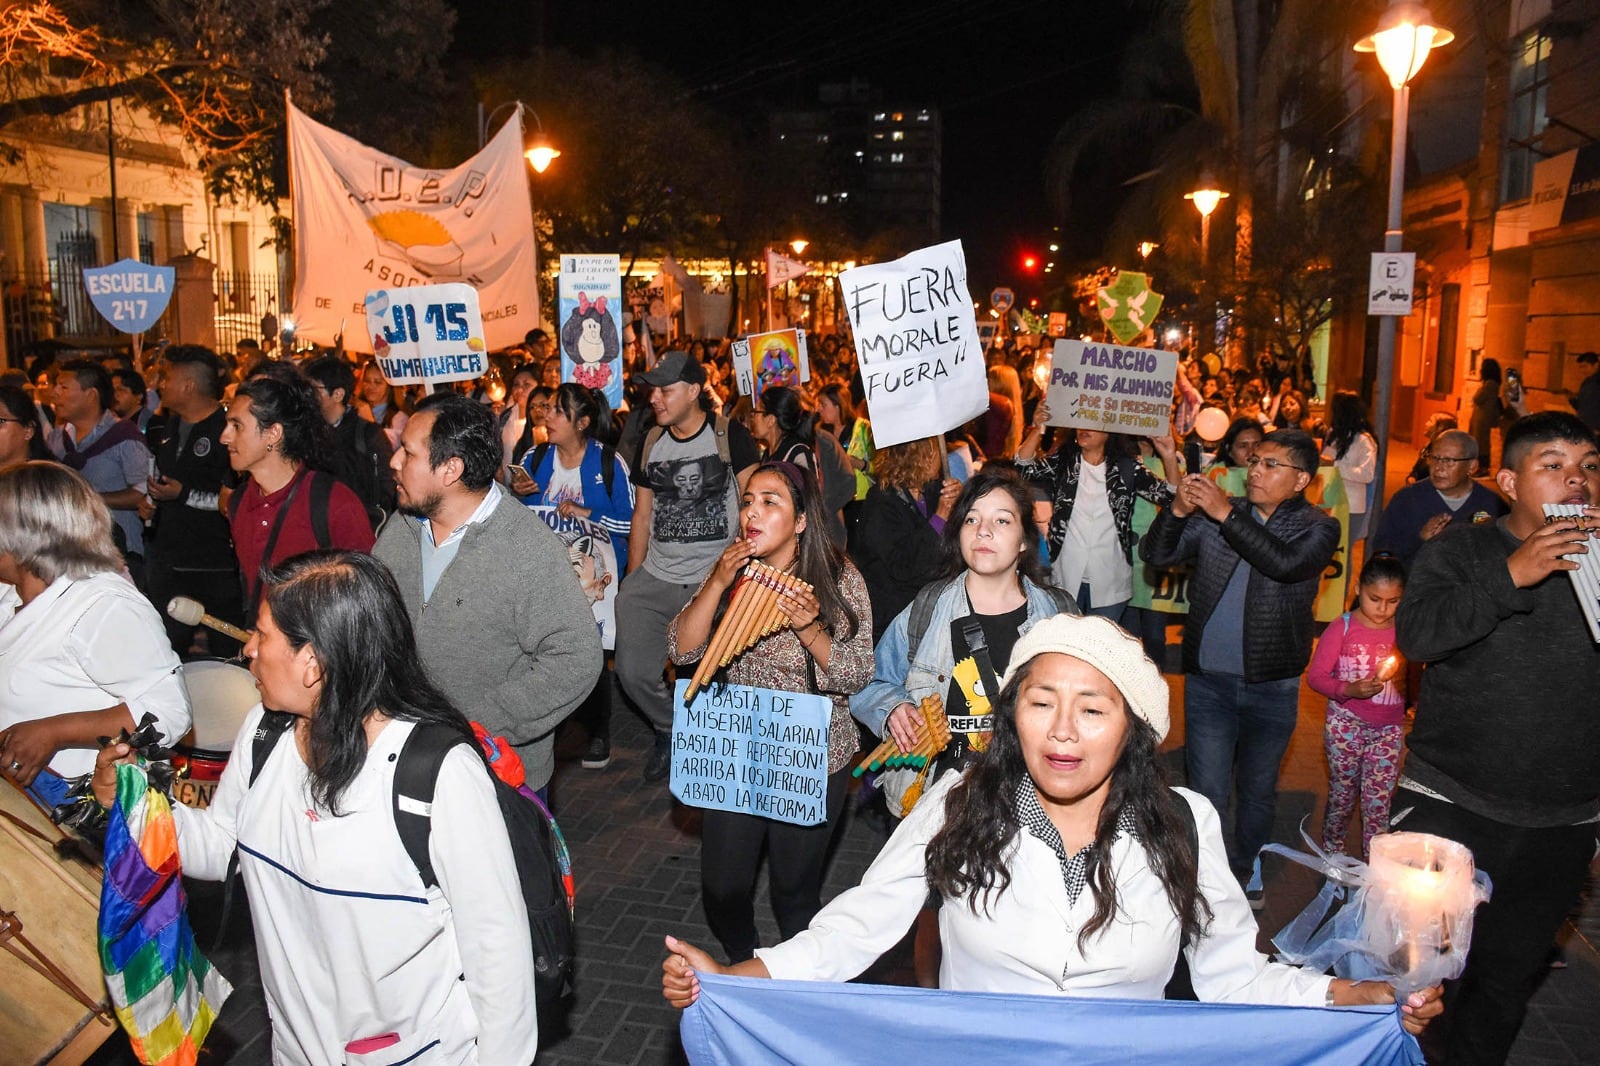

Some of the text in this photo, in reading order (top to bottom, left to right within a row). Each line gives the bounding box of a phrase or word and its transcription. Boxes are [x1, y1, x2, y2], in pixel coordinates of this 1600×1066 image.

[1386, 261, 1398, 279] E
[88, 272, 166, 295] ESCUELA
[111, 299, 148, 321] 247
[315, 296, 332, 309] DE
[383, 303, 470, 344] JI 15
[861, 315, 960, 365] MORALE
[380, 353, 482, 379] HUMAHUACA
[1080, 346, 1157, 373] MARCHO
[1051, 368, 1173, 399] POR MIS ALUMNOS
[1077, 407, 1159, 429] POR SU FUTURO
[1079, 394, 1171, 418] POR SU PRESENTE
[771, 696, 795, 717] DE
[686, 709, 829, 748] MISERIA SALARIAL!
[672, 731, 824, 770] ¡BASTA DE REPRESIÓN!
[675, 757, 823, 799] ¡ARRIBA LOS DERECHOS
[681, 782, 824, 822] ABAJO LA REFORMA!
